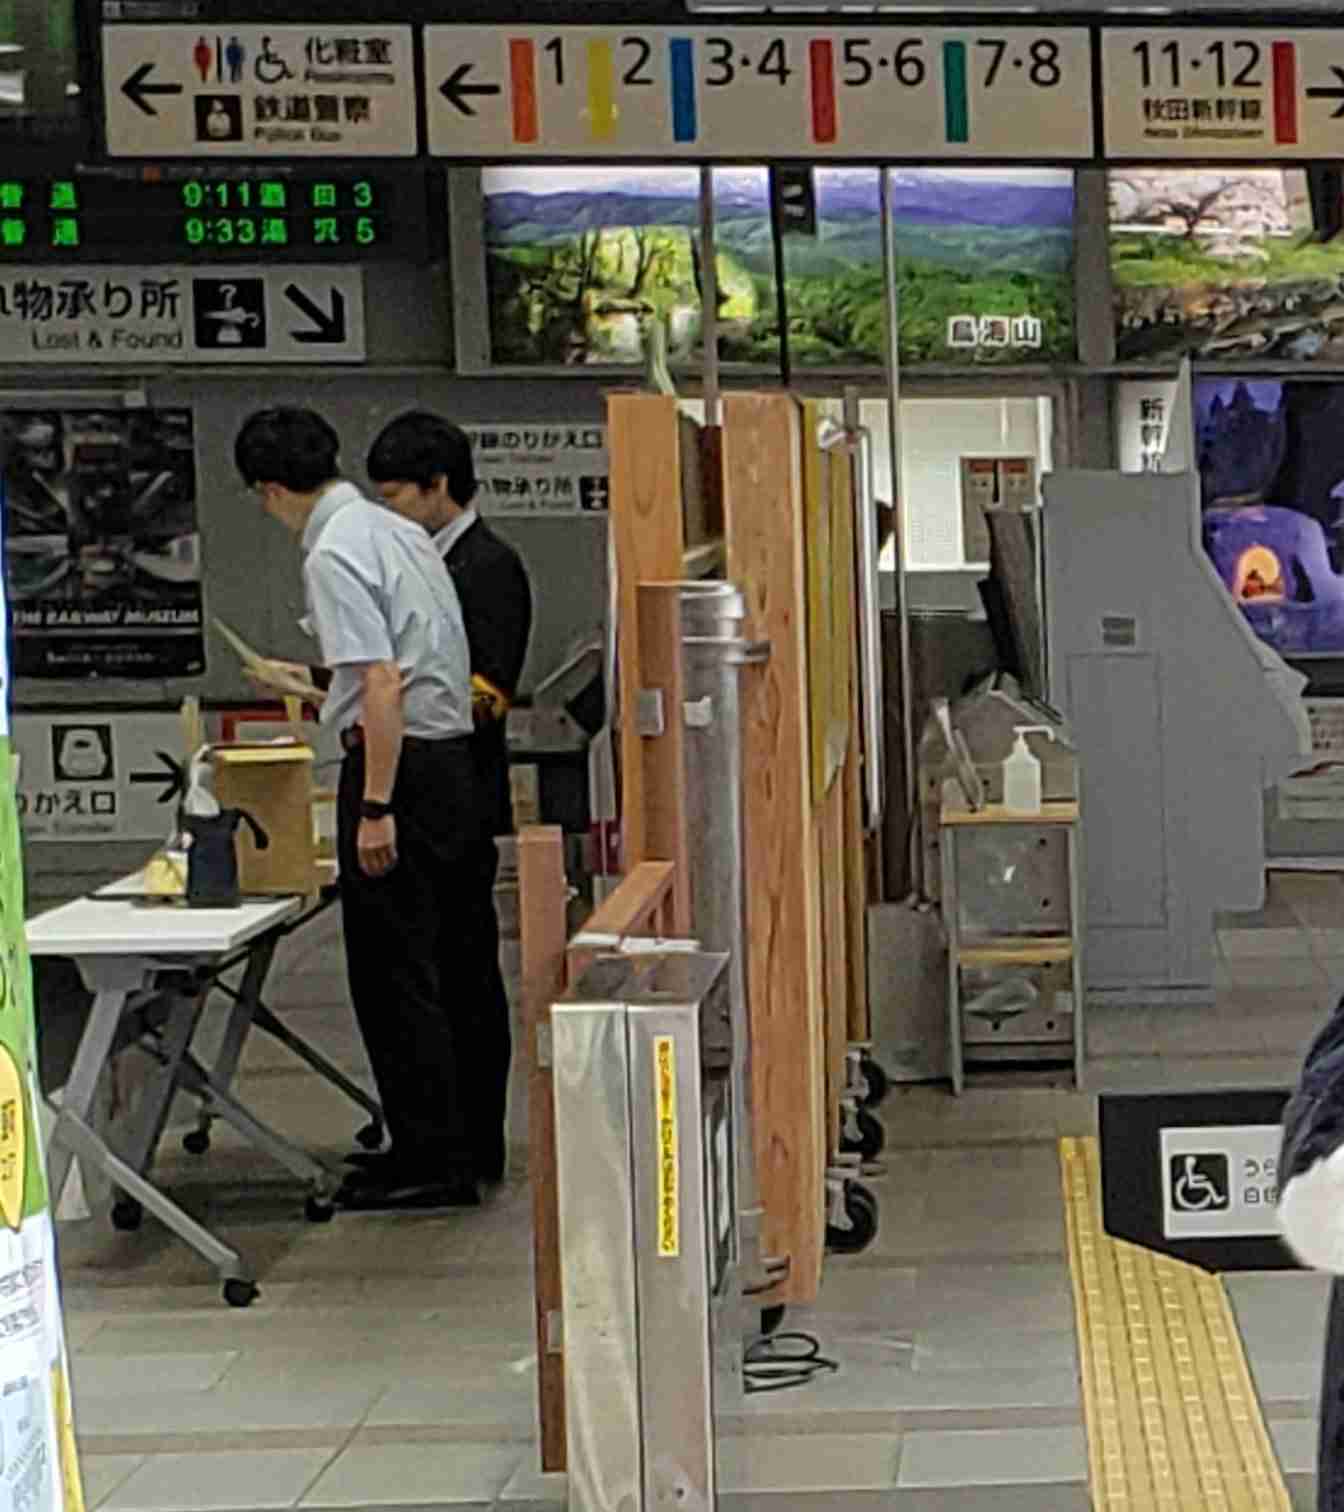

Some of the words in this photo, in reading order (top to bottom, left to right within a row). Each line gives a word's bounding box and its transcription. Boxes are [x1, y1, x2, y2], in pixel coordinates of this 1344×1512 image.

[543, 37, 565, 85] 1
[621, 37, 654, 86] 2
[183, 182, 251, 207] 9:11
[353, 182, 373, 207] 3
[185, 219, 255, 244] 9:33
[355, 218, 375, 244] 5
